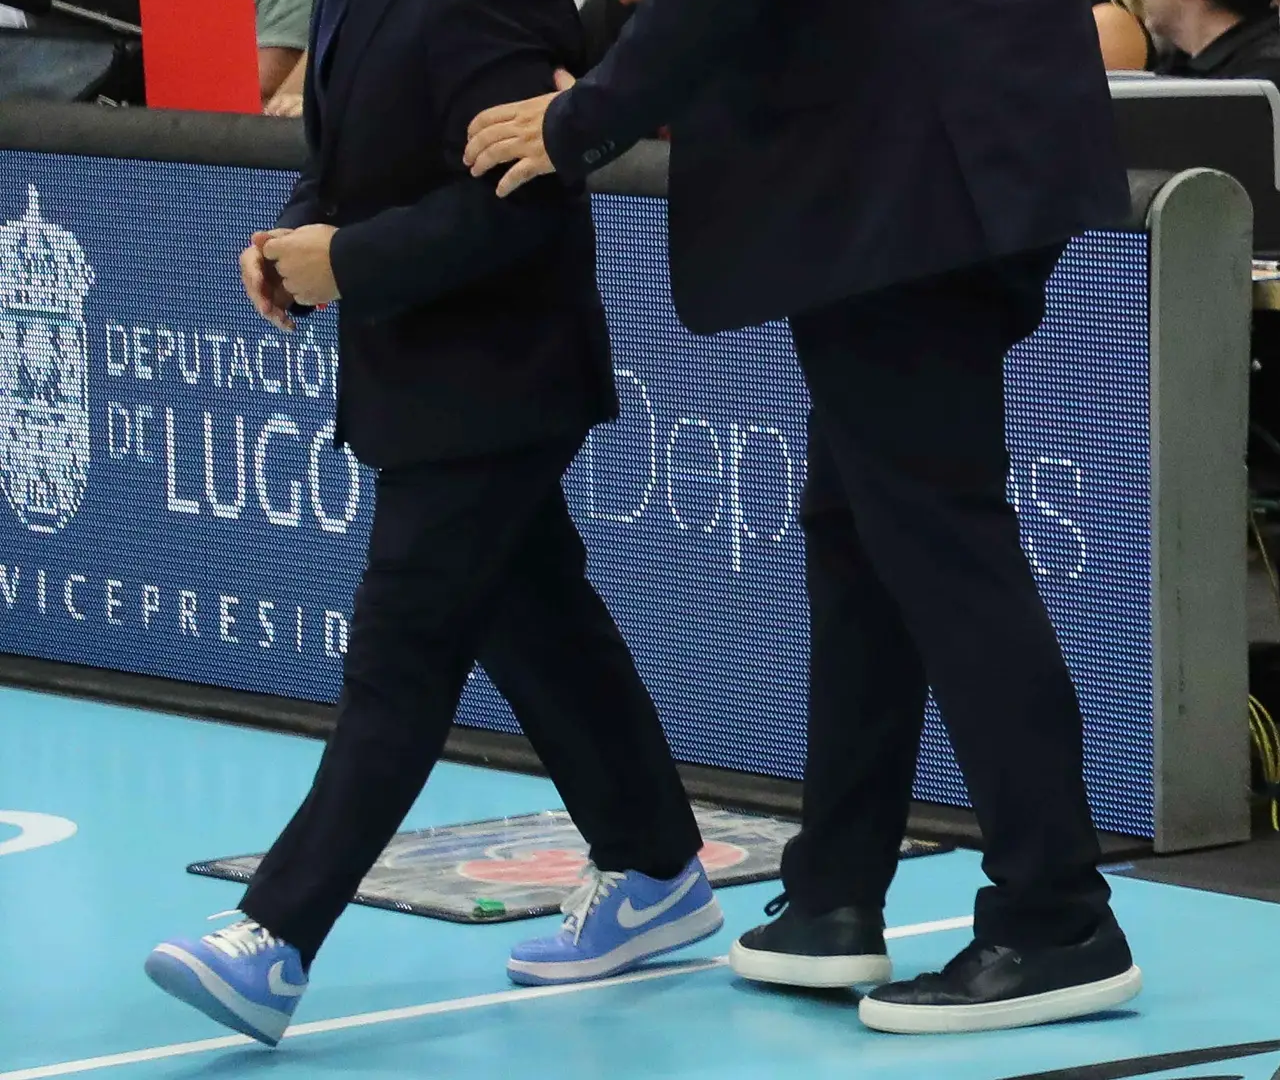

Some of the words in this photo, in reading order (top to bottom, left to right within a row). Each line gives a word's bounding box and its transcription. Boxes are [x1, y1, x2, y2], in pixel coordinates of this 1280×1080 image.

[106, 318, 339, 401] DEPUTACIÓ
[108, 401, 154, 463] DE
[165, 407, 360, 534] LUGO
